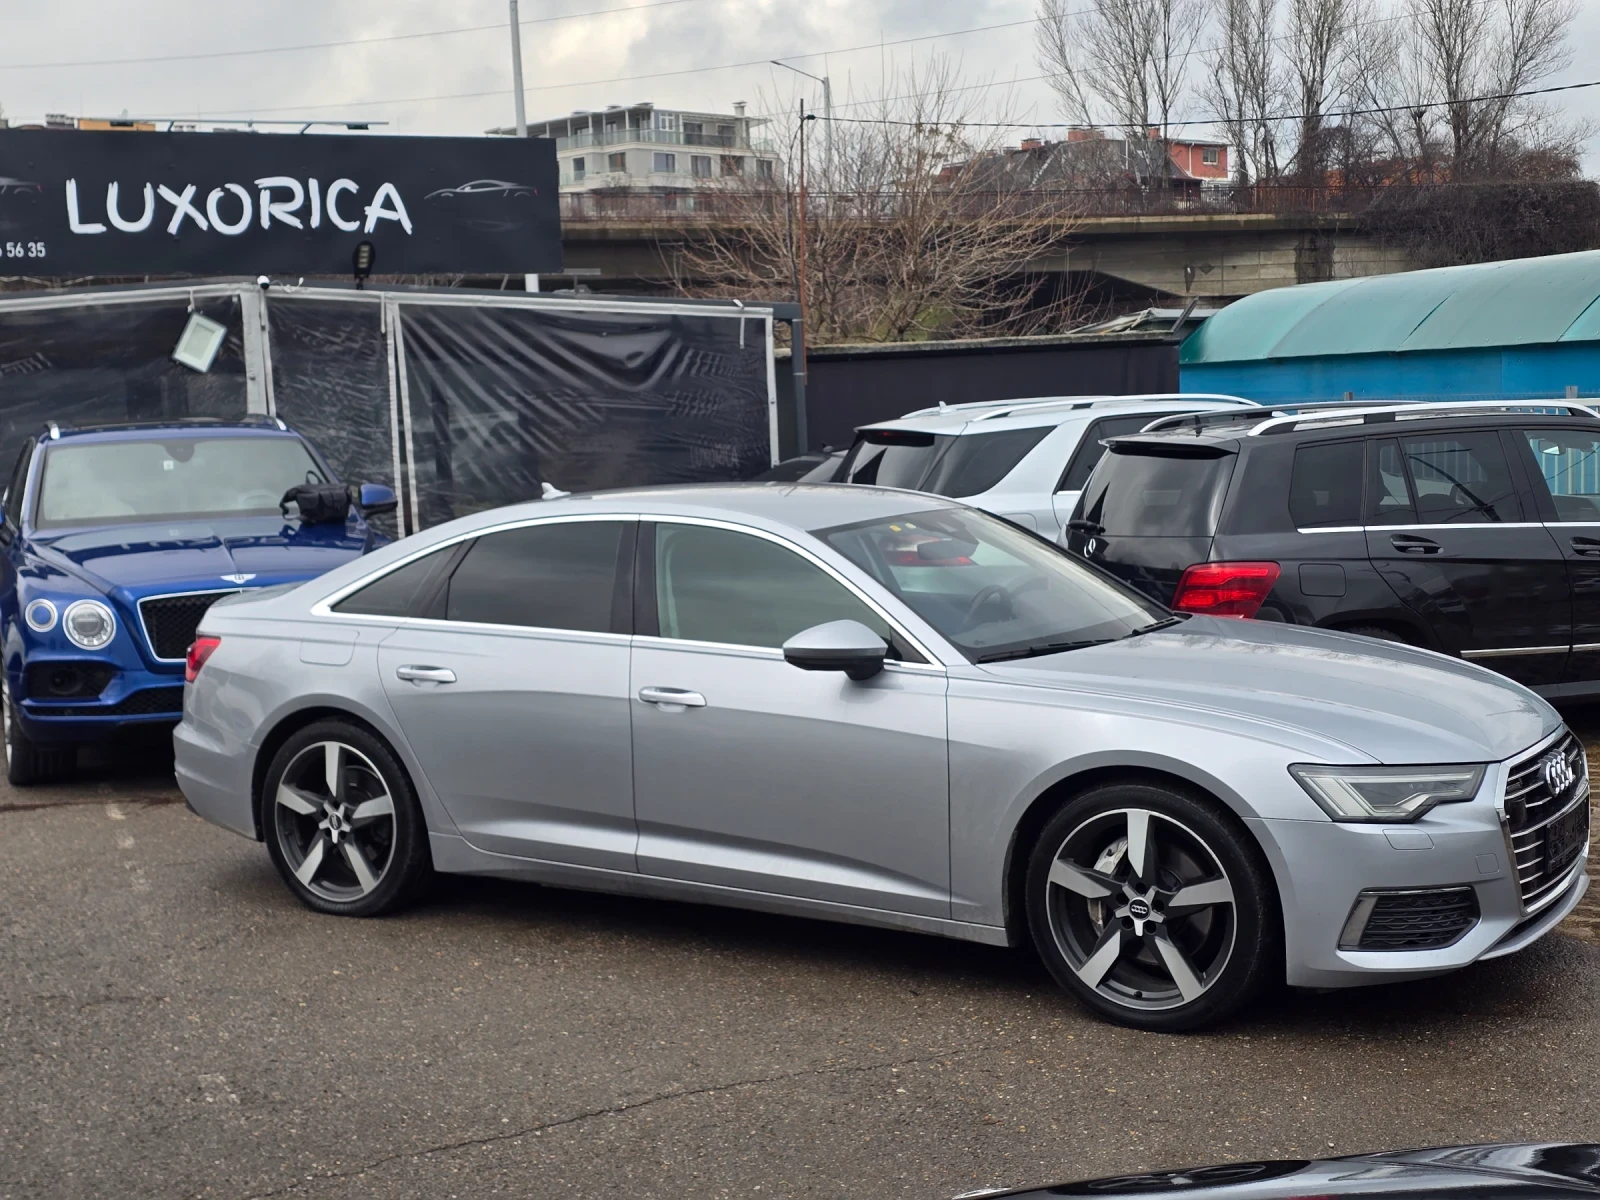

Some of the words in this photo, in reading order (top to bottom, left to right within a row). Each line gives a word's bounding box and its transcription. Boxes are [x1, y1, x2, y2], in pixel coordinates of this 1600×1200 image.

[65, 177, 412, 234] LUXORICA
[6, 242, 24, 257] 56
[28, 242, 46, 257] 35
